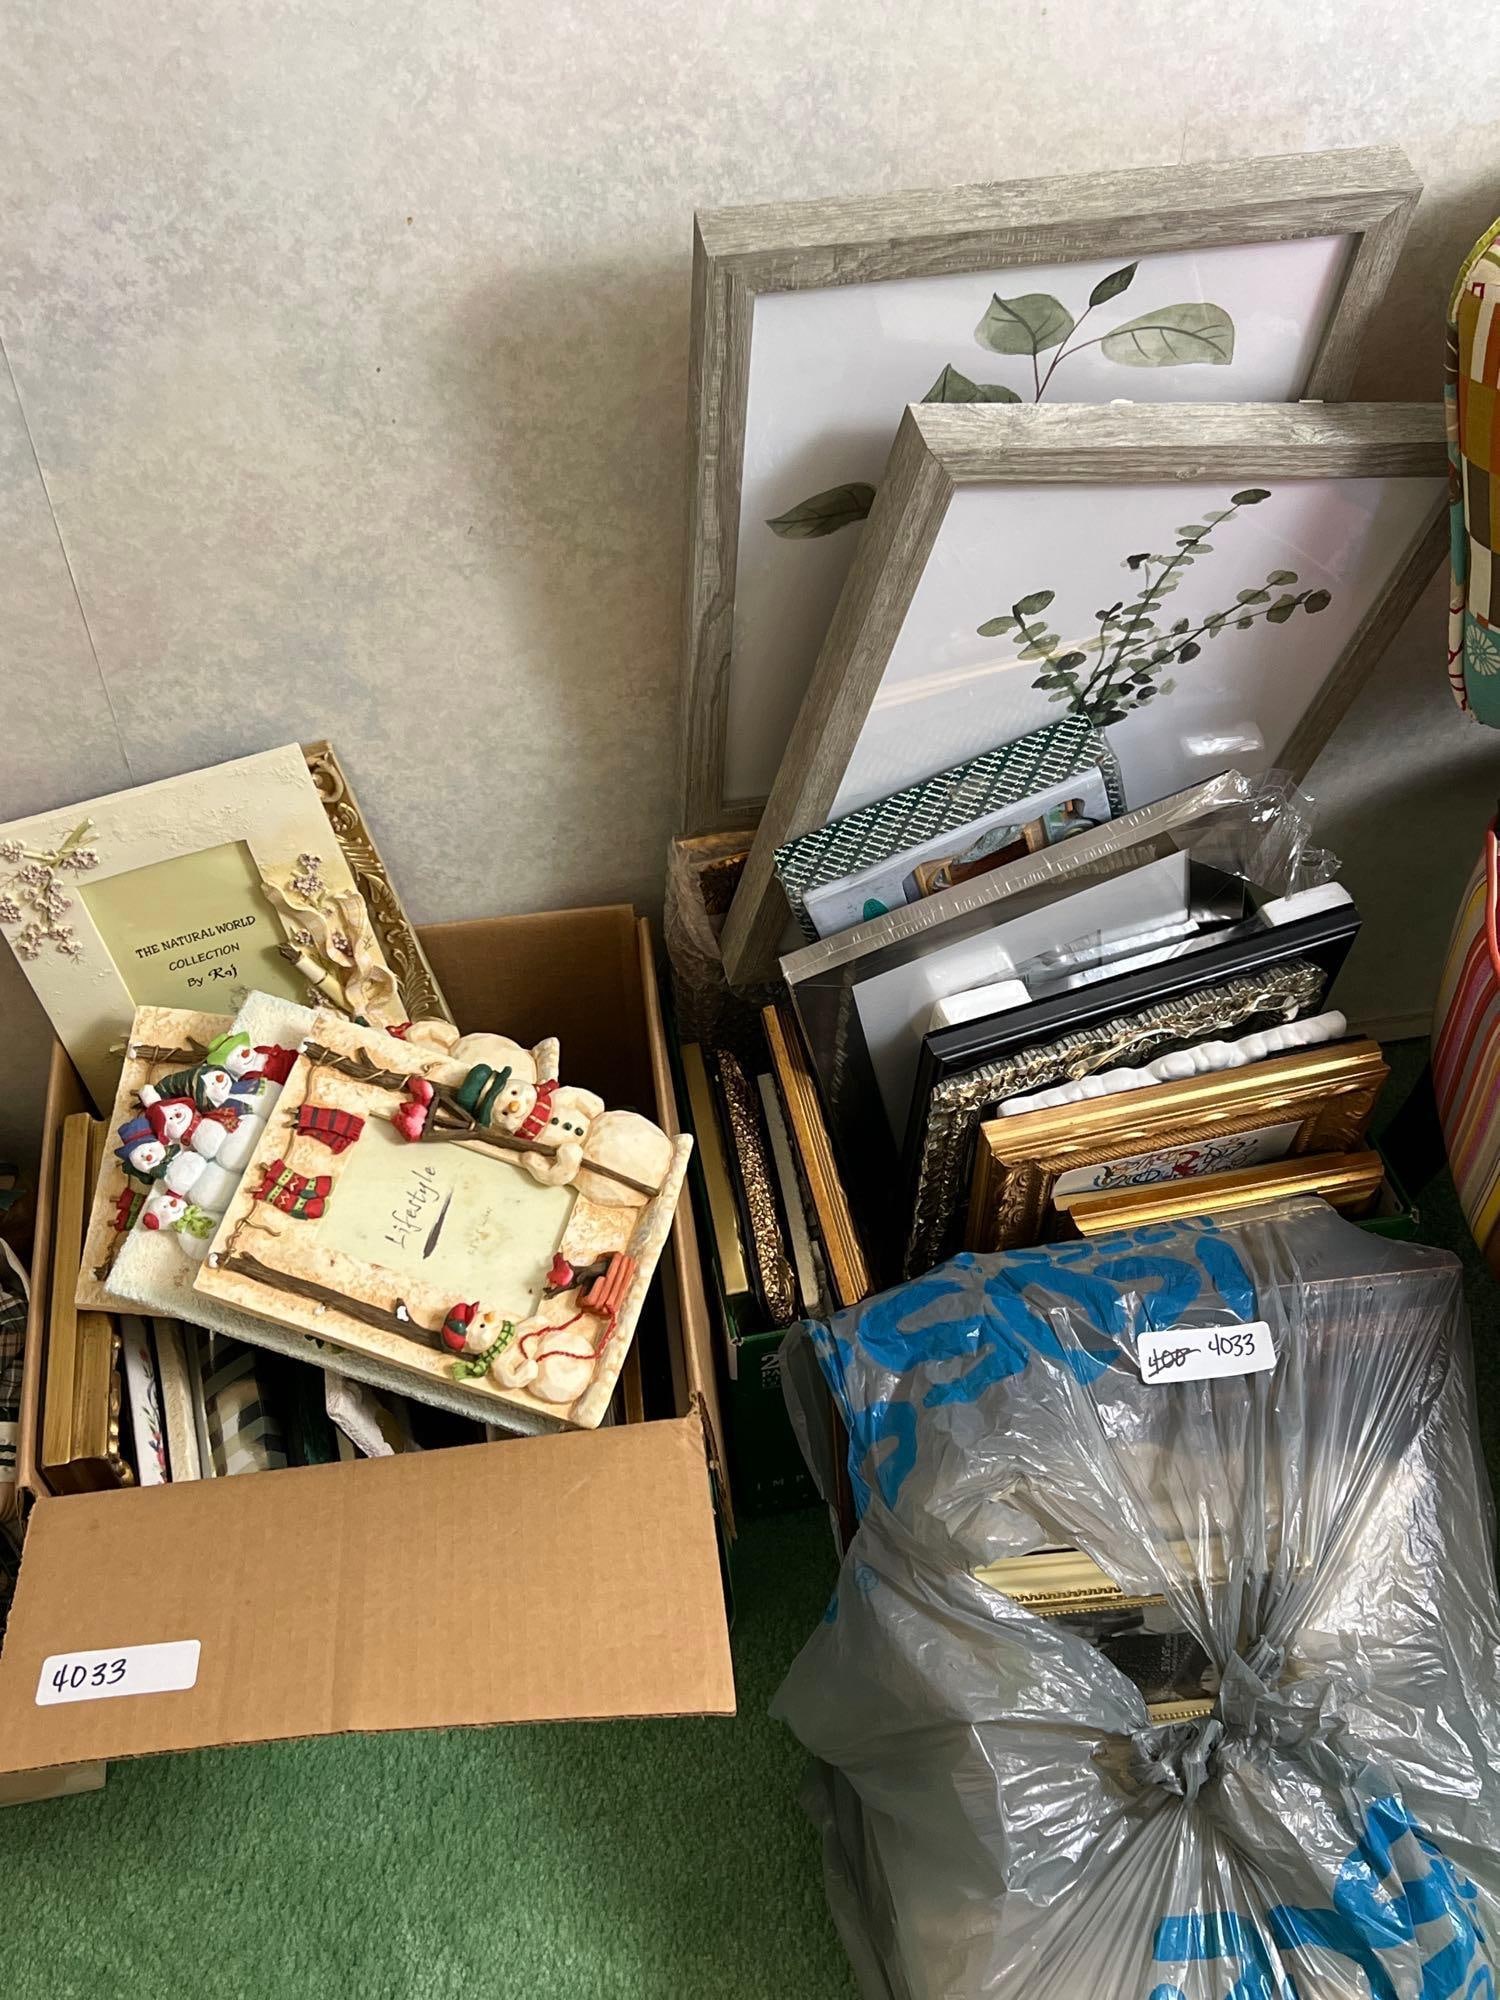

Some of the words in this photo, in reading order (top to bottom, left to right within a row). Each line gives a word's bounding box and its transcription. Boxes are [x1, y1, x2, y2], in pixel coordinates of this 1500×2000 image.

[135, 944, 160, 959] THE
[161, 928, 216, 951] NATURAL
[215, 915, 256, 935] WORLD
[168, 942, 240, 972] COLLECTION
[187, 977, 204, 988] By
[384, 1166, 441, 1249] Lifestyle
[1208, 1333, 1256, 1357] 4033
[52, 1658, 127, 1693] 4033
